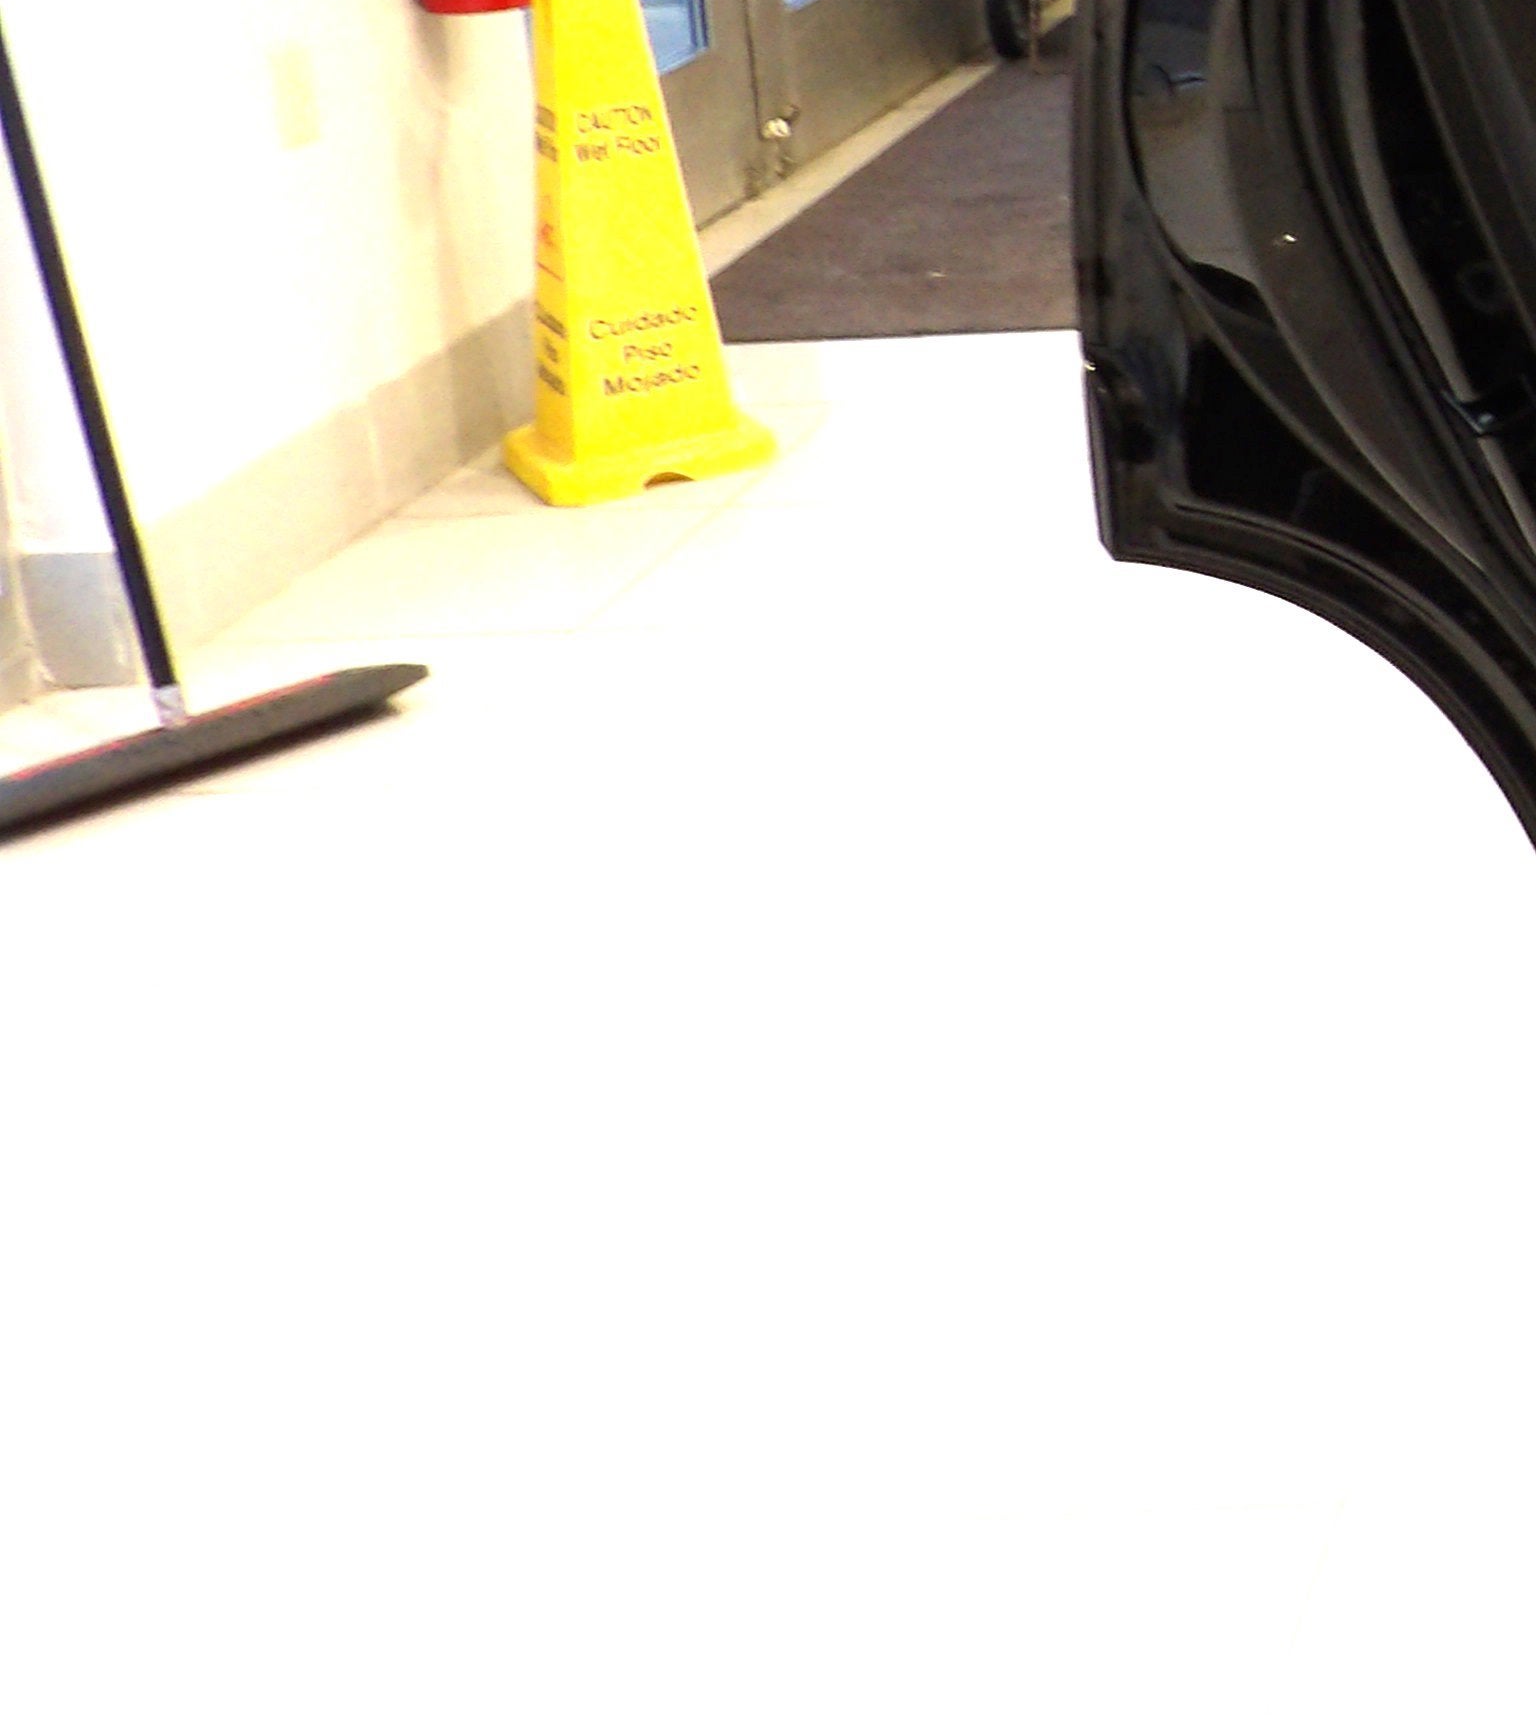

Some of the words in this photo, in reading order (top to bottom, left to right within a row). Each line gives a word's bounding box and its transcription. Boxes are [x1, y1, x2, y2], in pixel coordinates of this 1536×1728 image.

[576, 105, 653, 133] CAUTION
[589, 306, 698, 339] Cuidado
[623, 341, 673, 363] Piso
[603, 363, 701, 396] Mojado
